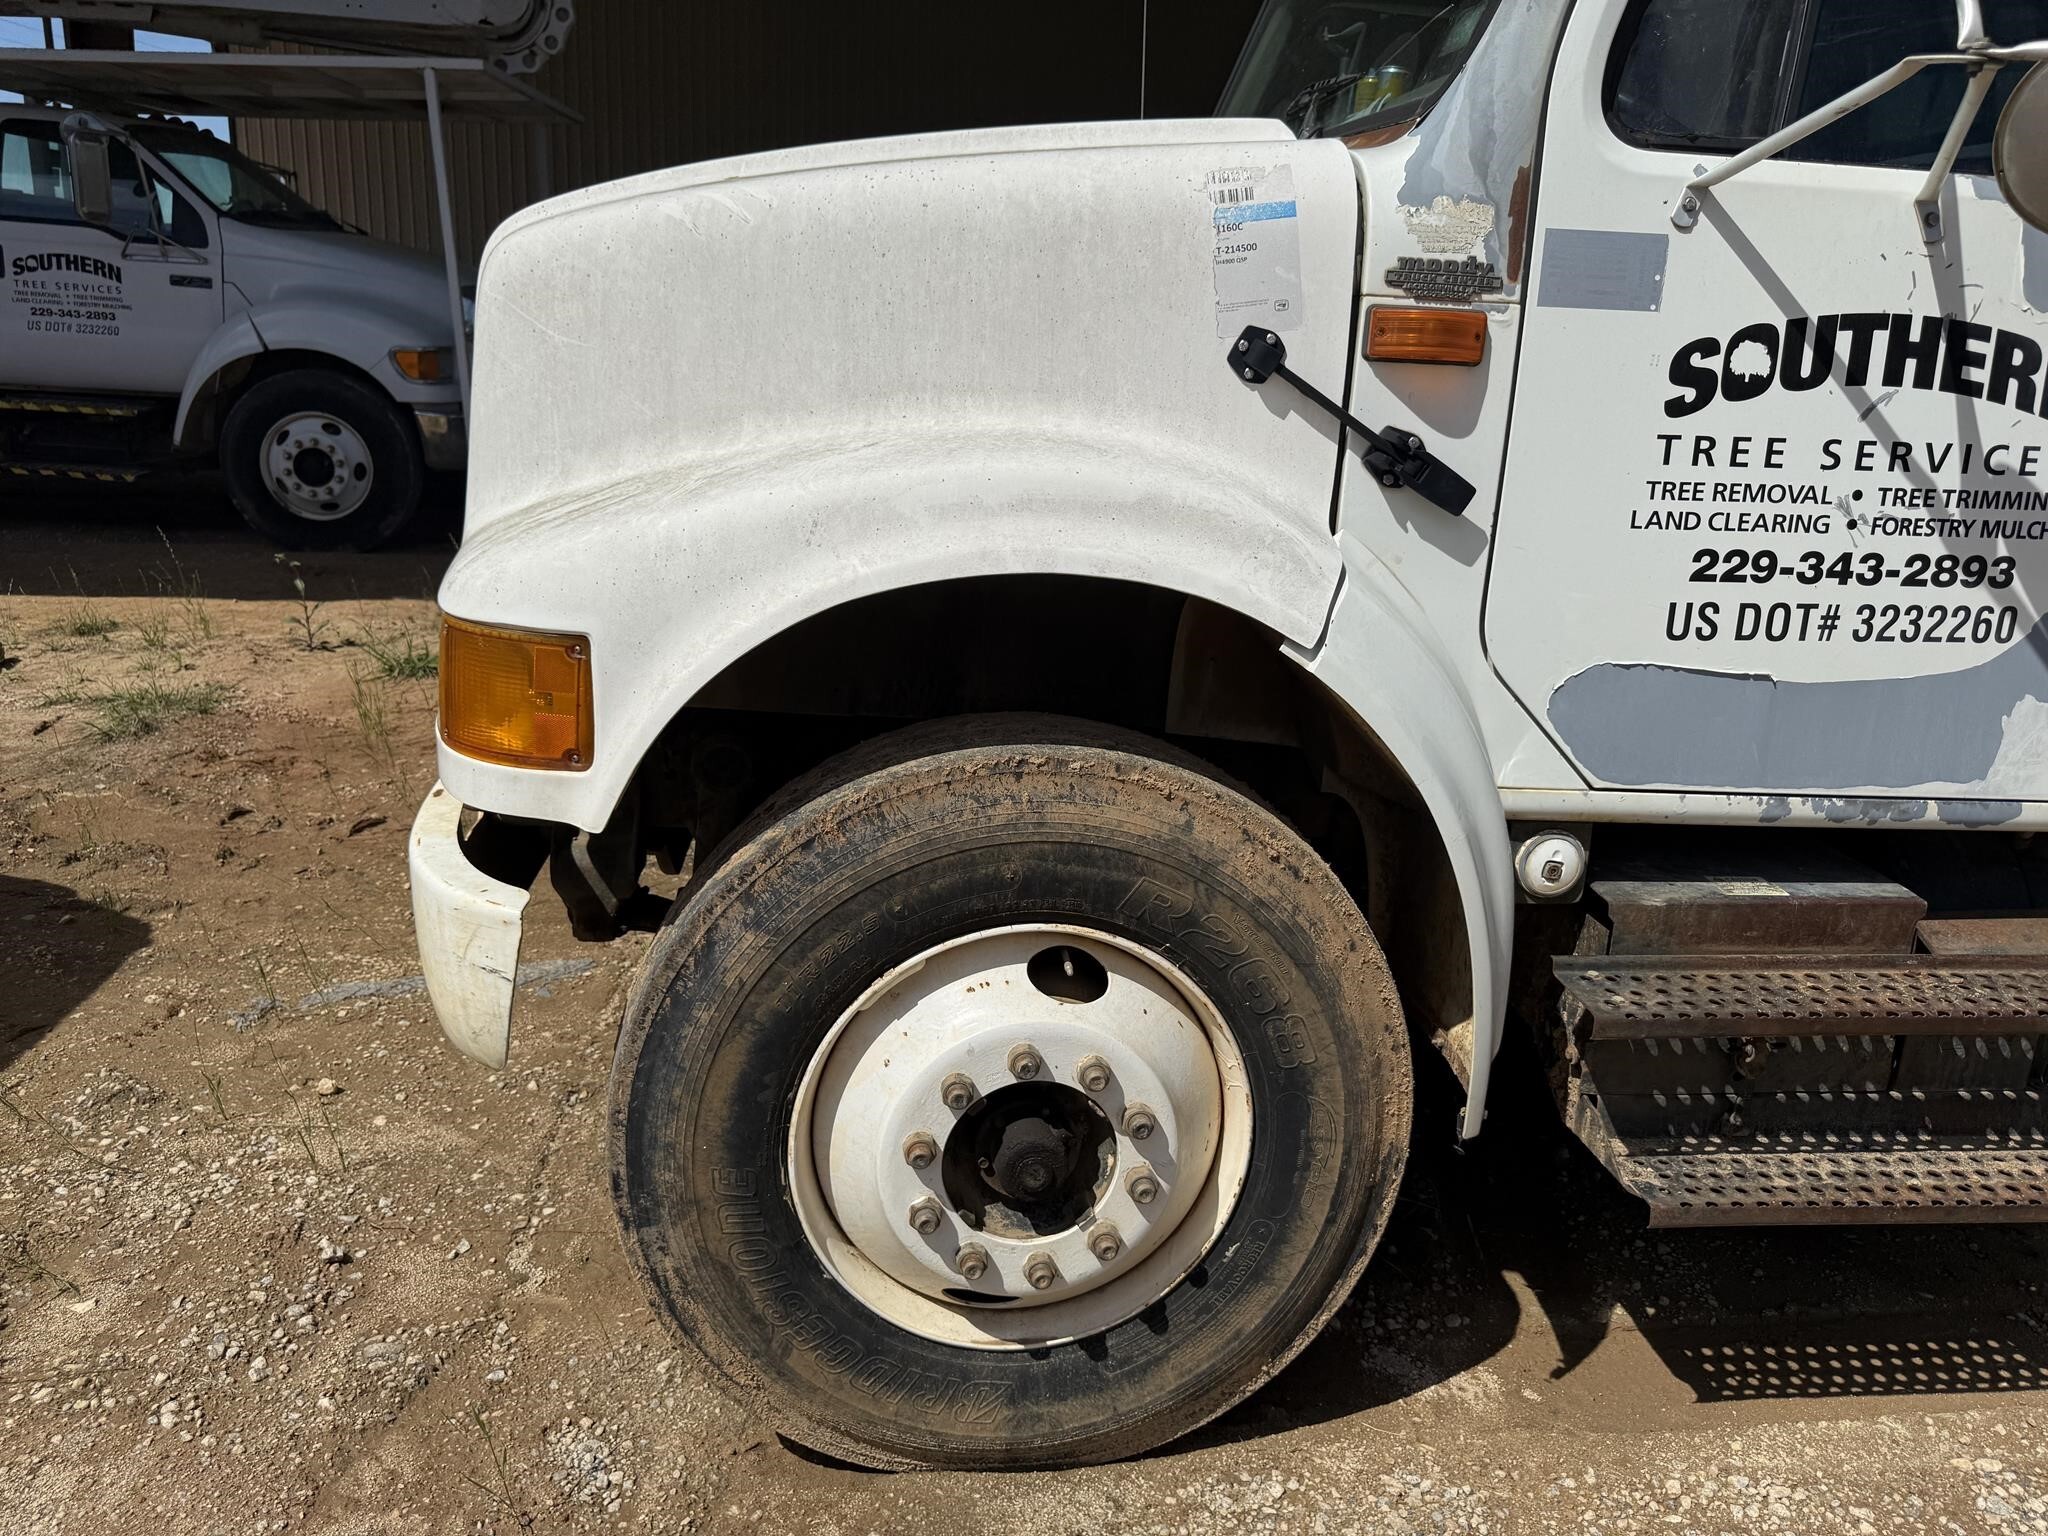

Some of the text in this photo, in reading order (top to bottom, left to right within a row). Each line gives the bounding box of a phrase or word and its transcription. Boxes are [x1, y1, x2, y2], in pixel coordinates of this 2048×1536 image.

[1216, 243, 1258, 254] T-214500
[12, 253, 122, 284] SOUTHERN
[1394, 272, 1494, 285] TRUCK CENTER
[14, 280, 122, 295] TREE SERVICES
[30, 291, 62, 299] REMOVAL
[90, 295, 124, 303] TRIMMING
[30, 307, 116, 321] 229-343-2893
[31, 298, 64, 306] CLEARING
[27, 320, 120, 336] US DOT# 3232260
[1664, 313, 2048, 420] SOUTHER
[1657, 434, 2041, 477] TREE SERVICE
[1646, 480, 1706, 502] TREE
[1712, 482, 1833, 505] REMOVAL
[1877, 487, 1936, 508] TREE
[1630, 510, 1702, 531] LAND
[1708, 512, 1831, 534] CLEARING
[1870, 516, 1978, 538] FORESTRY
[1689, 548, 2017, 589] 229-343-2893
[1666, 601, 2018, 645] US DOT# 3232260
[1115, 876, 1319, 1068] R268
